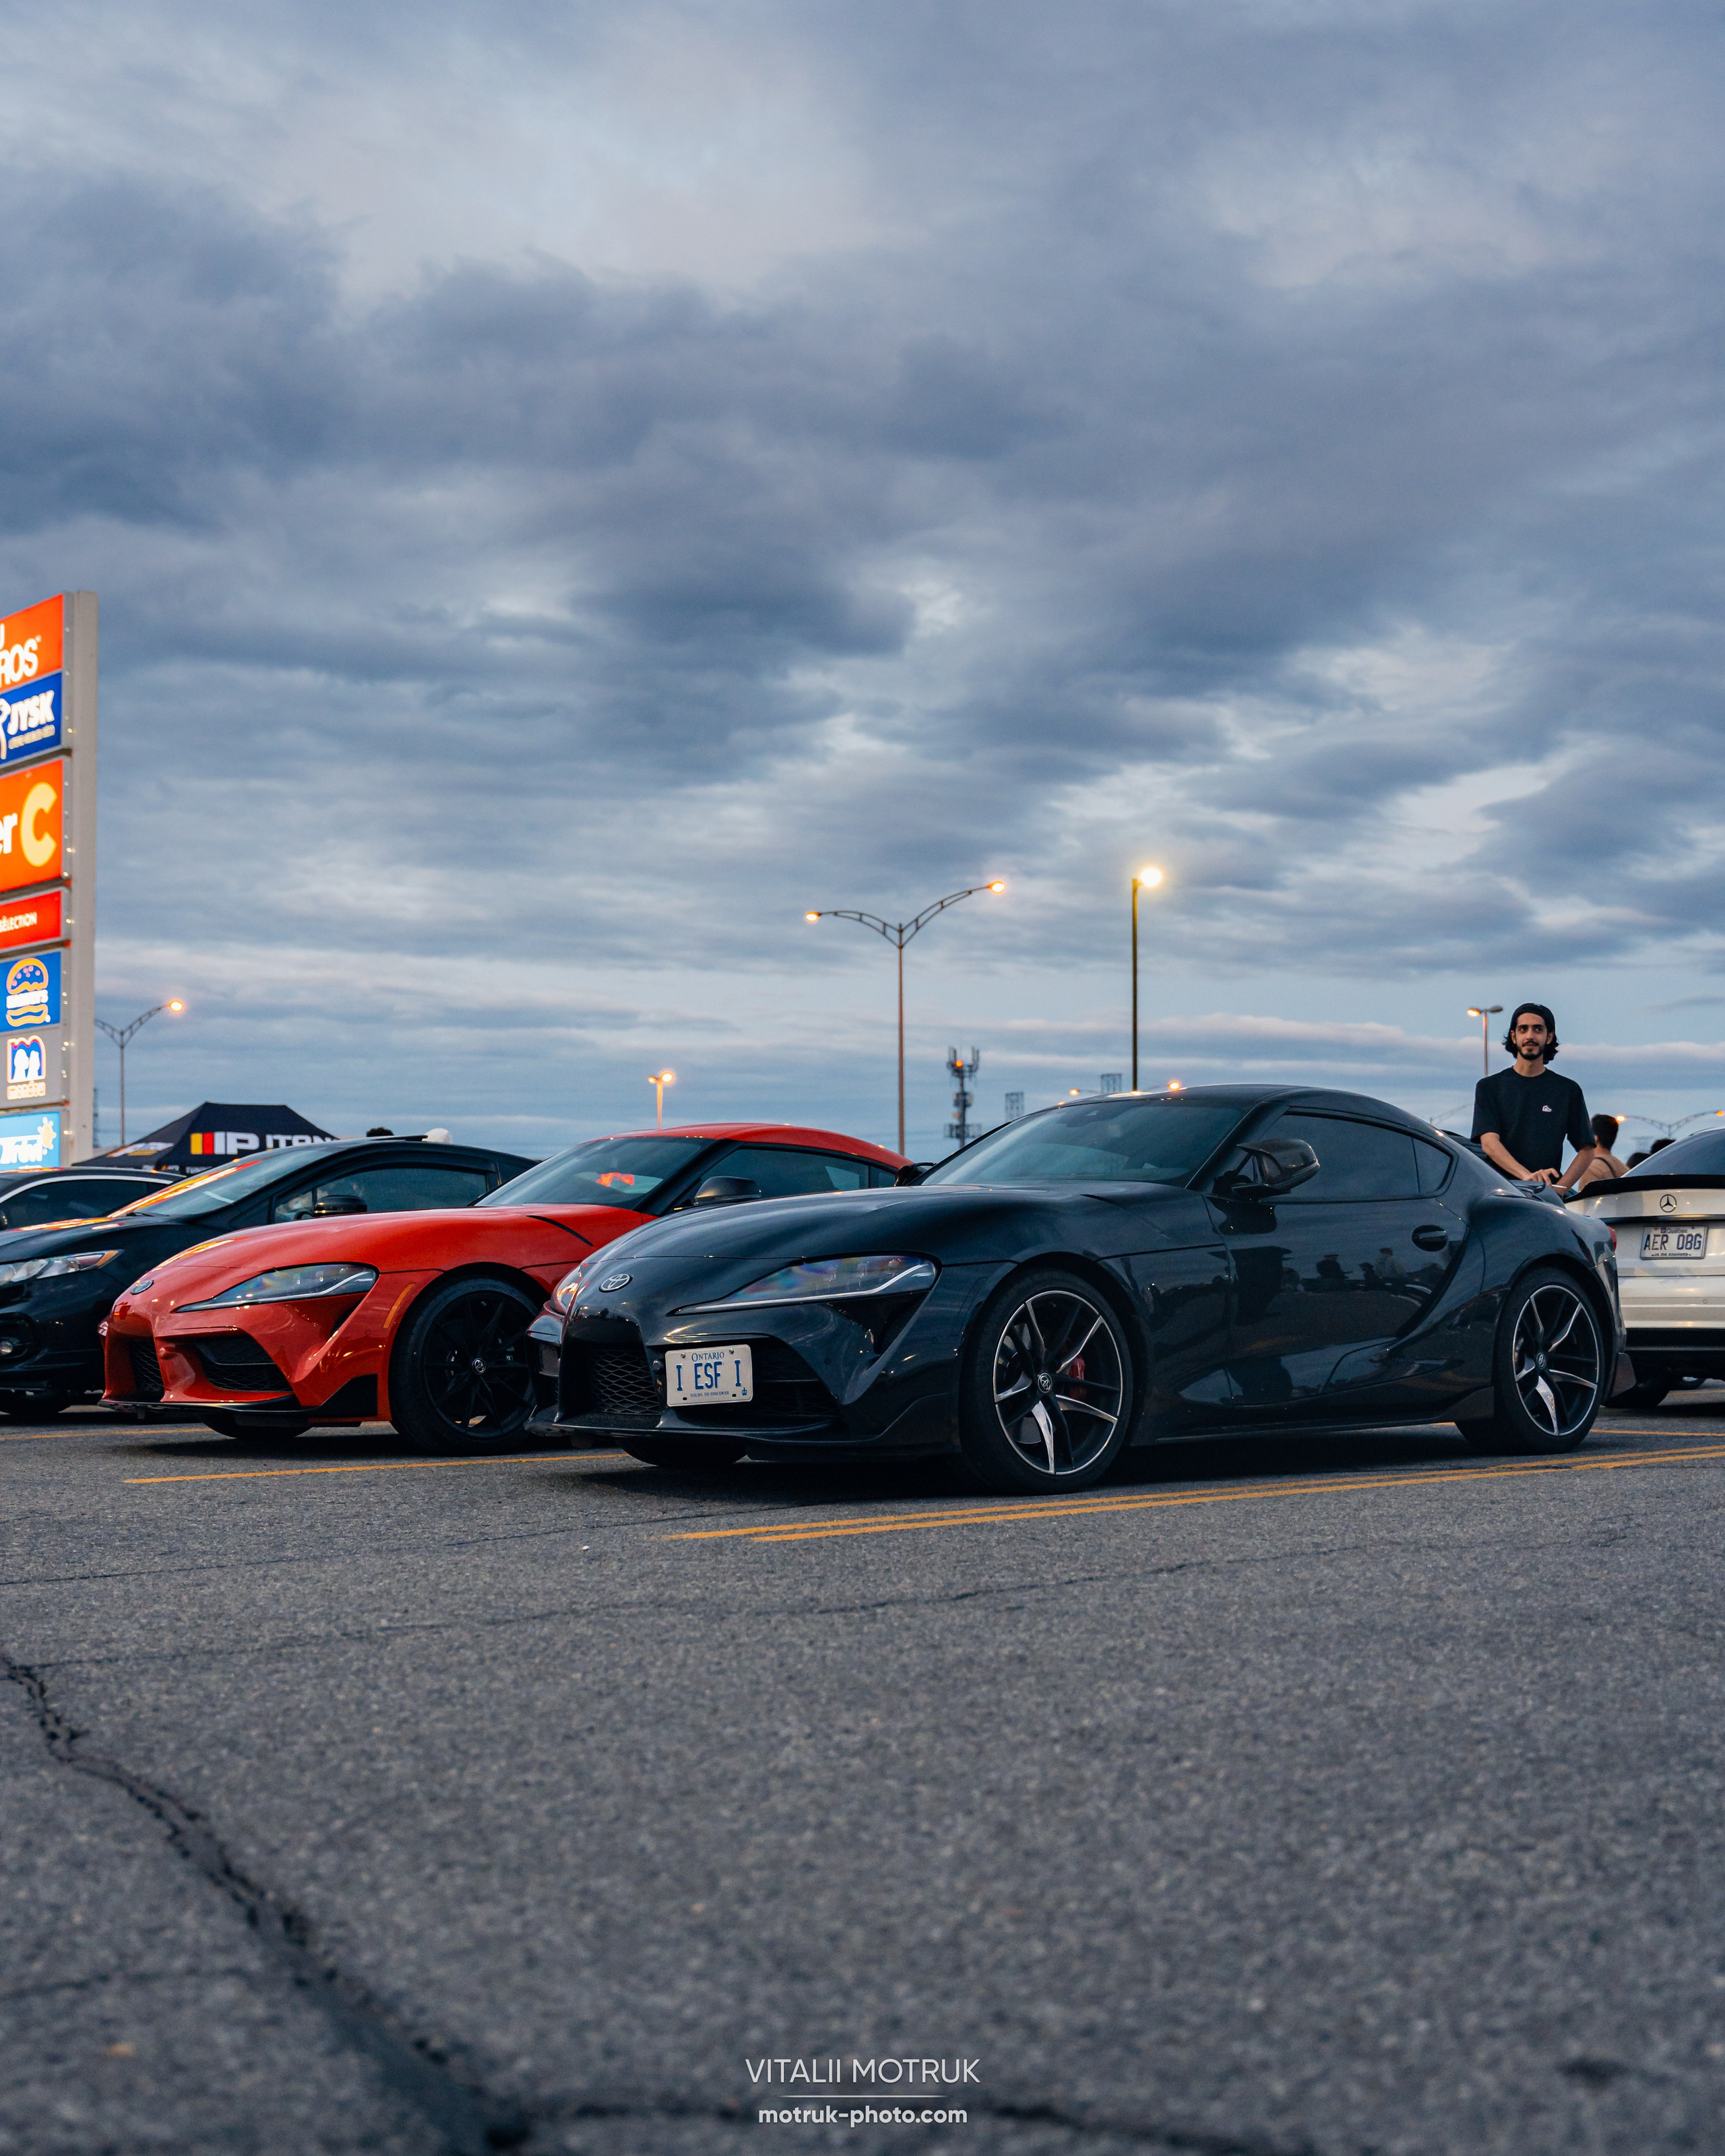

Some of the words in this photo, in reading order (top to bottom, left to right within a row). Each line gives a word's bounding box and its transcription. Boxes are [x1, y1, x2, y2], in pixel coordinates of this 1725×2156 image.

[7, 690, 55, 735] JYSK
[20, 782, 57, 867] C
[1643, 1234, 1668, 1250] AER
[676, 1364, 683, 1391] I
[694, 1361, 722, 1390] ESF
[734, 1360, 741, 1387] I
